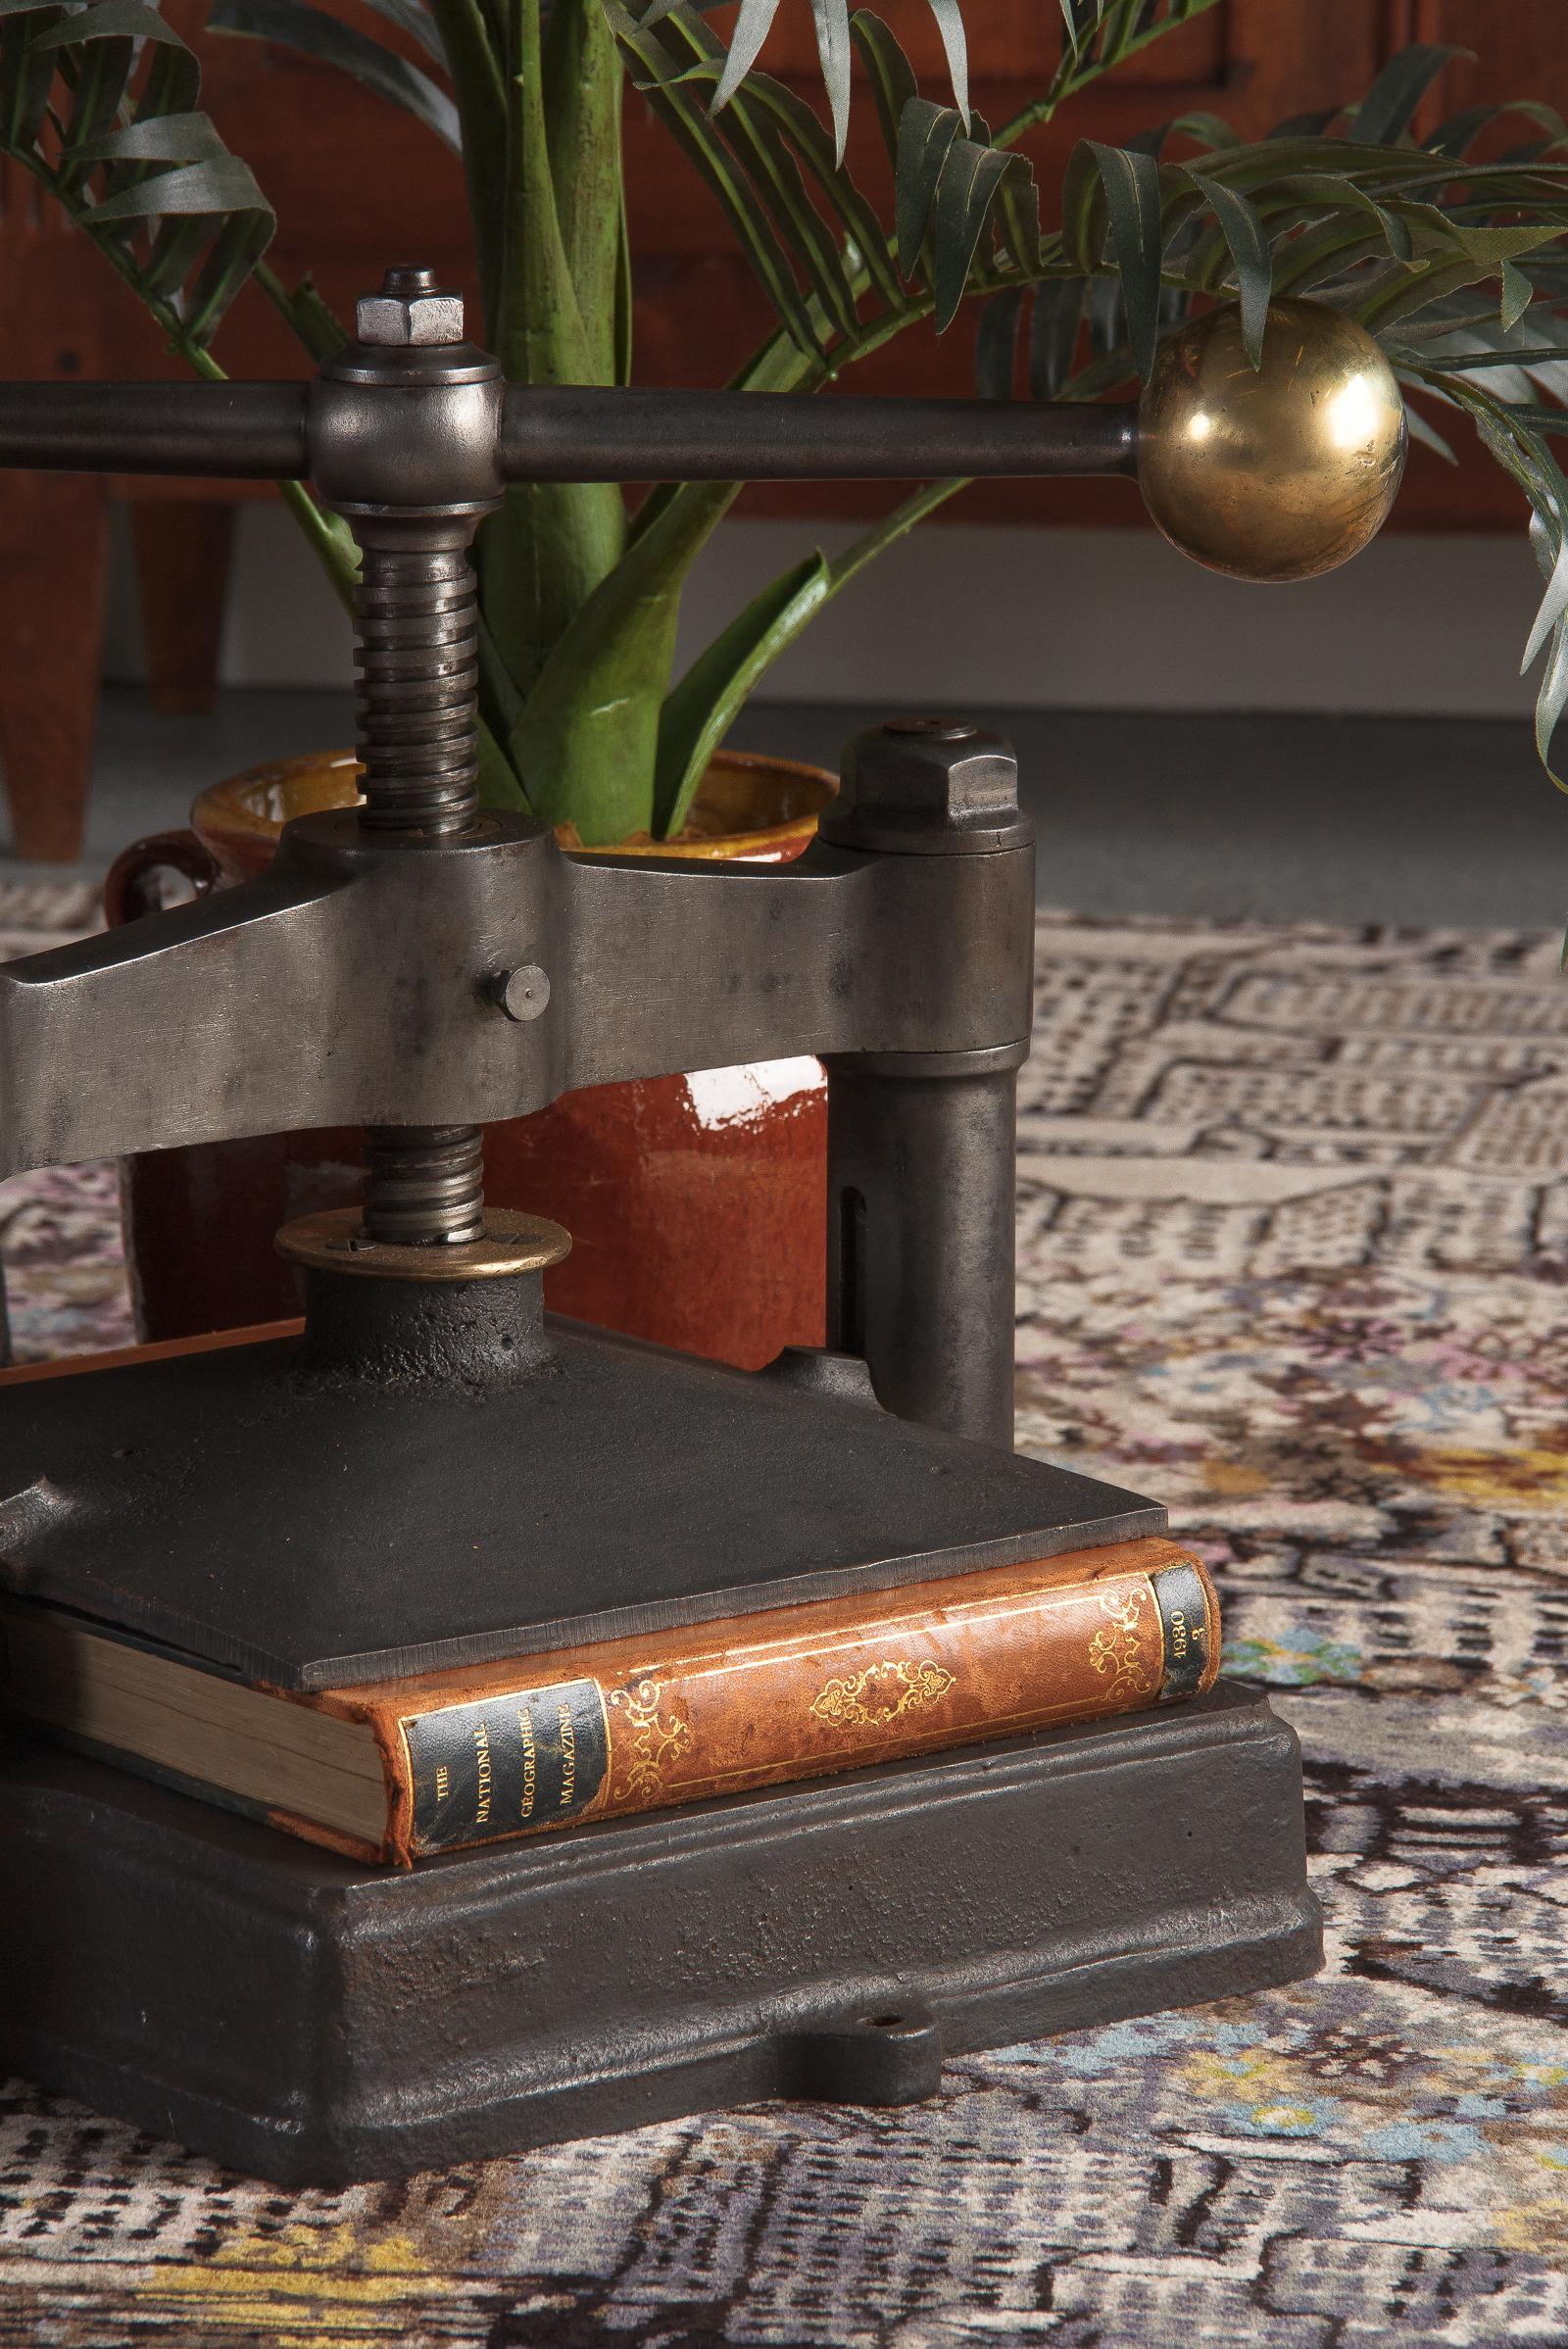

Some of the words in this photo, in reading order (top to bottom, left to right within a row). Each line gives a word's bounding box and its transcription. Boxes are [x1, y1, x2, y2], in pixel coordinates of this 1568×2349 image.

[1170, 1610, 1187, 1659] 1930
[436, 1766, 449, 1801] THE
[472, 1722, 492, 1824] NATIONAL
[517, 1708, 535, 1818] GEOGRAPHIC
[558, 1703, 575, 1805] MAGAZINE
